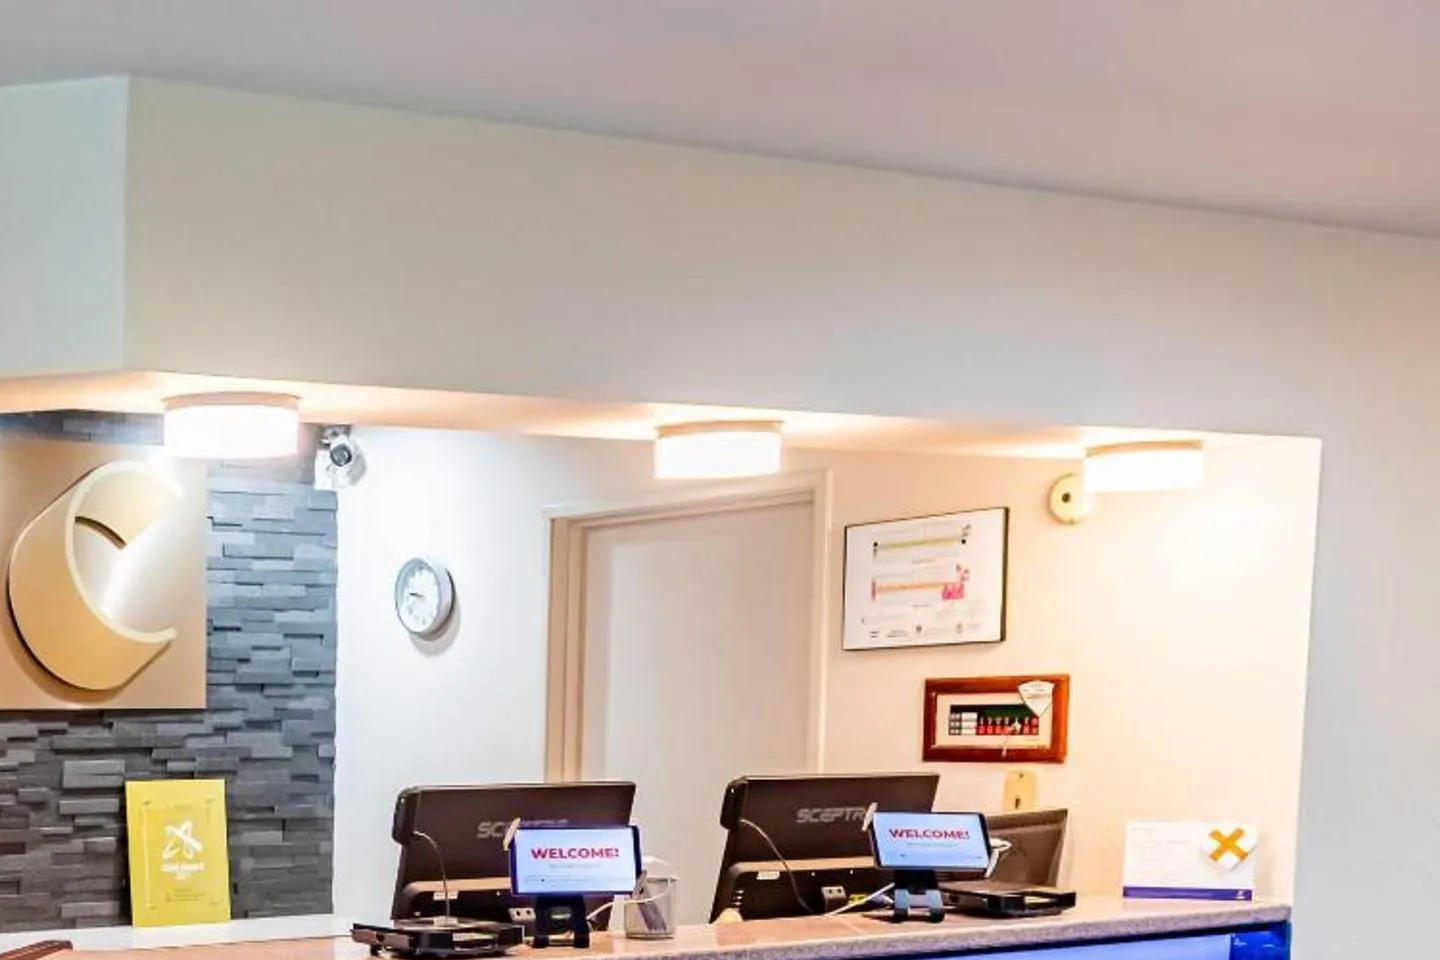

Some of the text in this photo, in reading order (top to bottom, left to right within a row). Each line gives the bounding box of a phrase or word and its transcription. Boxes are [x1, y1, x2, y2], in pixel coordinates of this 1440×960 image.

[796, 806, 866, 823] SCEPTR
[889, 828, 970, 840] WELCOME!
[531, 847, 619, 859] WELCOME!
